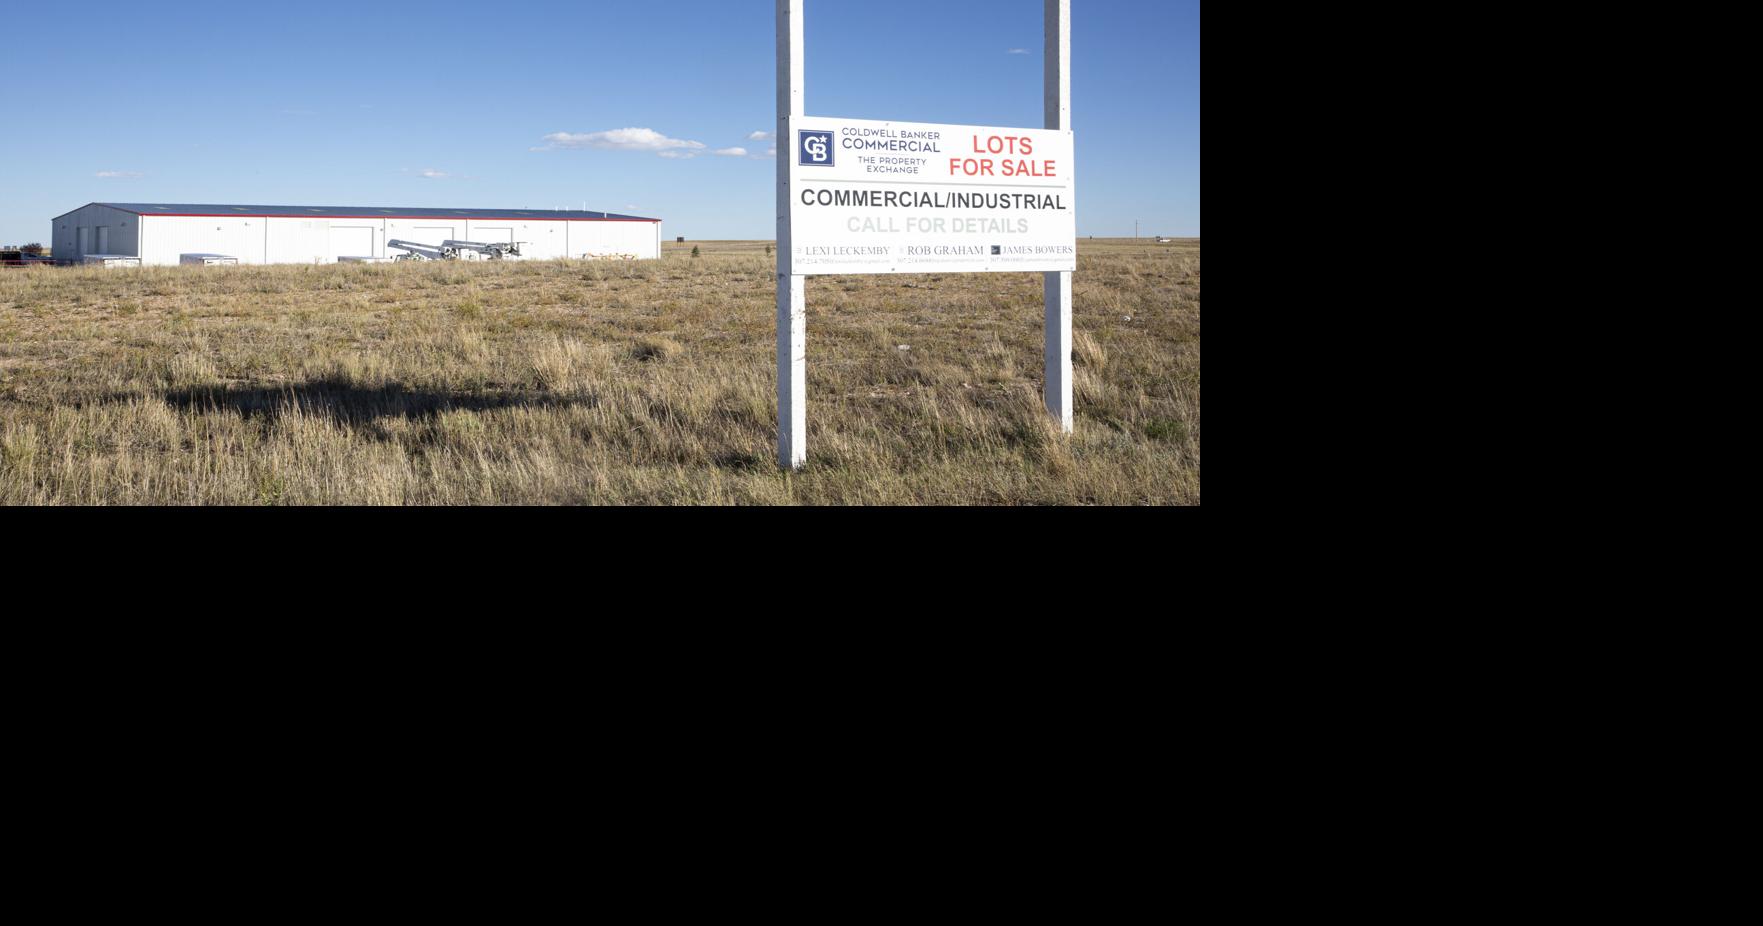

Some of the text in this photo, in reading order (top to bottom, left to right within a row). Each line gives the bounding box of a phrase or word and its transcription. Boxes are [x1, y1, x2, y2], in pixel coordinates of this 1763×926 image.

[842, 127, 941, 140] COLDWELL BANKER
[842, 137, 941, 153] COMMERCIAL
[973, 135, 1033, 155] LOTS
[858, 156, 927, 166] THE PROPERTY
[949, 158, 1057, 177] FOR SALE
[866, 165, 919, 174] EXCHANGE
[801, 189, 1066, 210] COMMERCIAL/INDUSTRIAL
[847, 216, 1028, 234] CALL FOR DETAILS
[805, 245, 891, 256] LEXI LECKEMBY
[907, 245, 984, 256] ROB GRAHAM
[1002, 245, 1073, 255] JAMES BOWERS
